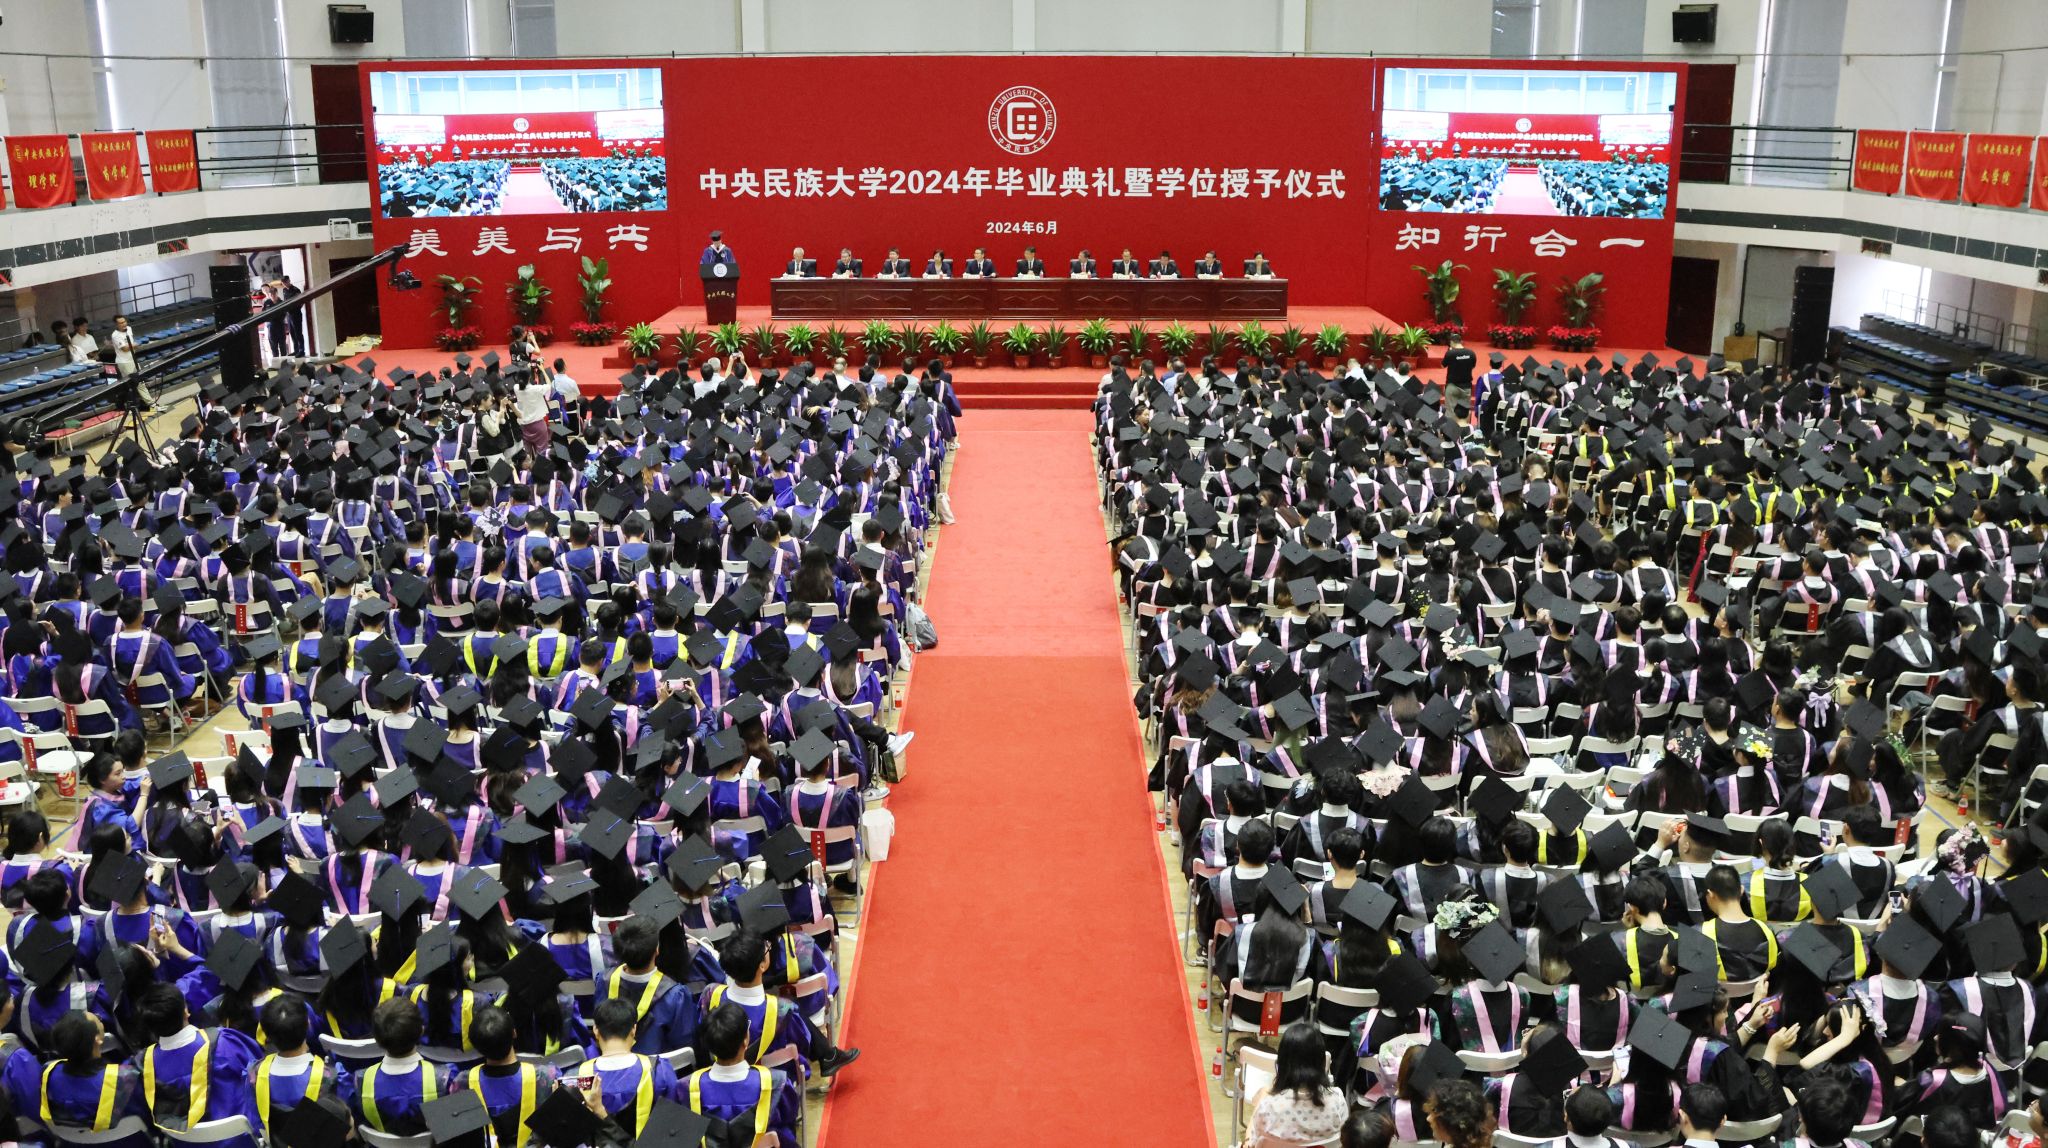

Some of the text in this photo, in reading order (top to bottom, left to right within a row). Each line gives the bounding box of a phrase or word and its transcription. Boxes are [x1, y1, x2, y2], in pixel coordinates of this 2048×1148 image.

[991, 107, 999, 130] MINZU
[998, 89, 1037, 104] UNIVERSITY
[1039, 98, 1048, 106] OF
[998, 137, 1047, 153] 中央民族大学
[28, 172, 59, 189] 理学院
[699, 166, 1346, 200] 中央民族大学2024年毕业典礼暨学位授予仪式
[405, 224, 650, 258] 美美与共
[986, 220, 1059, 236] 2024年6月
[1396, 222, 1645, 258] 知行合一
